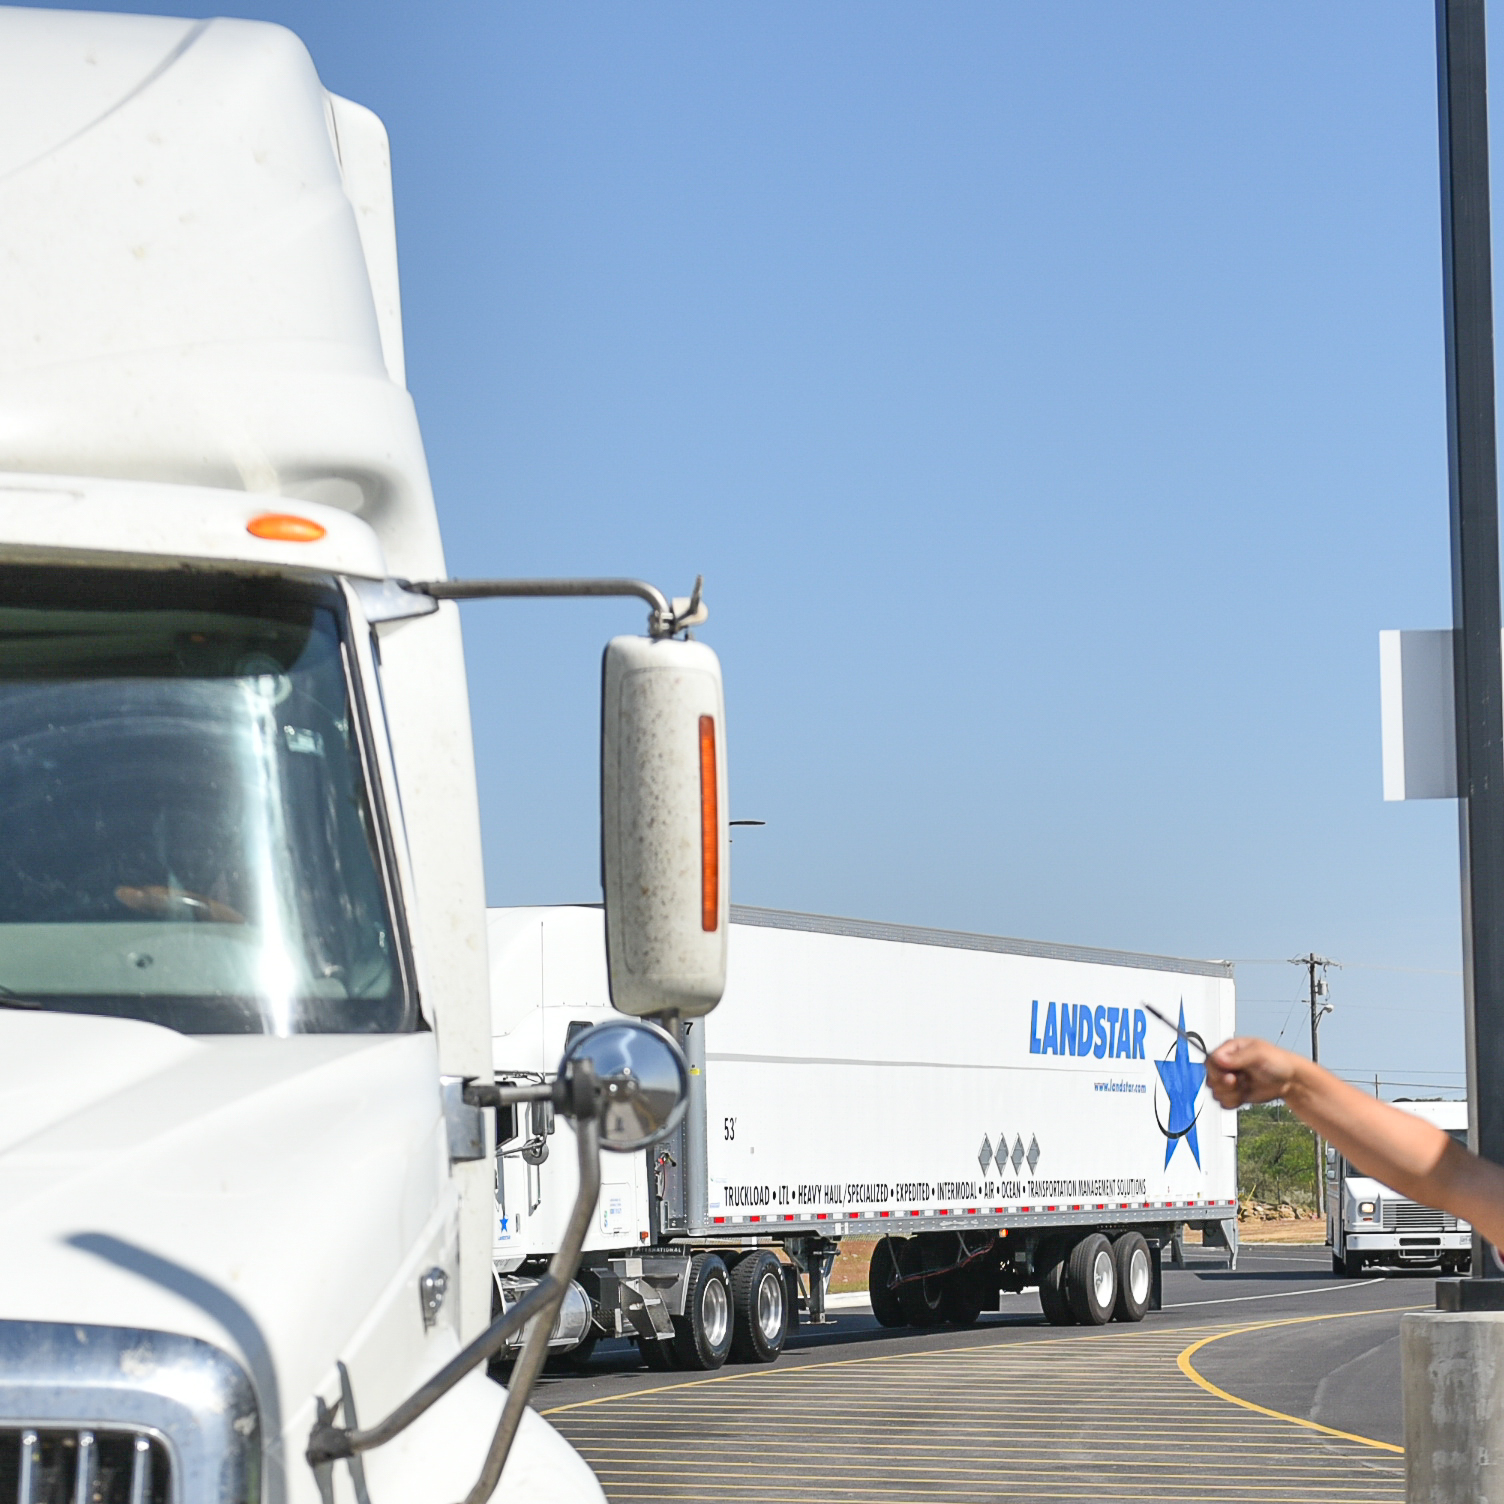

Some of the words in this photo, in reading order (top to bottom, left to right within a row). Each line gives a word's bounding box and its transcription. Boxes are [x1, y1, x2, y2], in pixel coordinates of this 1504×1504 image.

[1029, 1000, 1146, 1059] LANDSTAR
[1094, 1079, 1146, 1093] www.landstar.com
[724, 1186, 770, 1206] TRUCKLOAD
[778, 1185, 789, 1205] LTL
[798, 1184, 822, 1205] HEAVY
[896, 1182, 930, 1202] EXPEDITED
[937, 1181, 977, 1200] INTERMODAL
[984, 1181, 994, 1199] AIR
[1001, 1180, 1020, 1198] OCEAN
[1027, 1179, 1077, 1198] TRANSPORTATION
[1078, 1178, 1116, 1197] MANAGEMENT
[1116, 1178, 1146, 1196] SOLUTIONS
